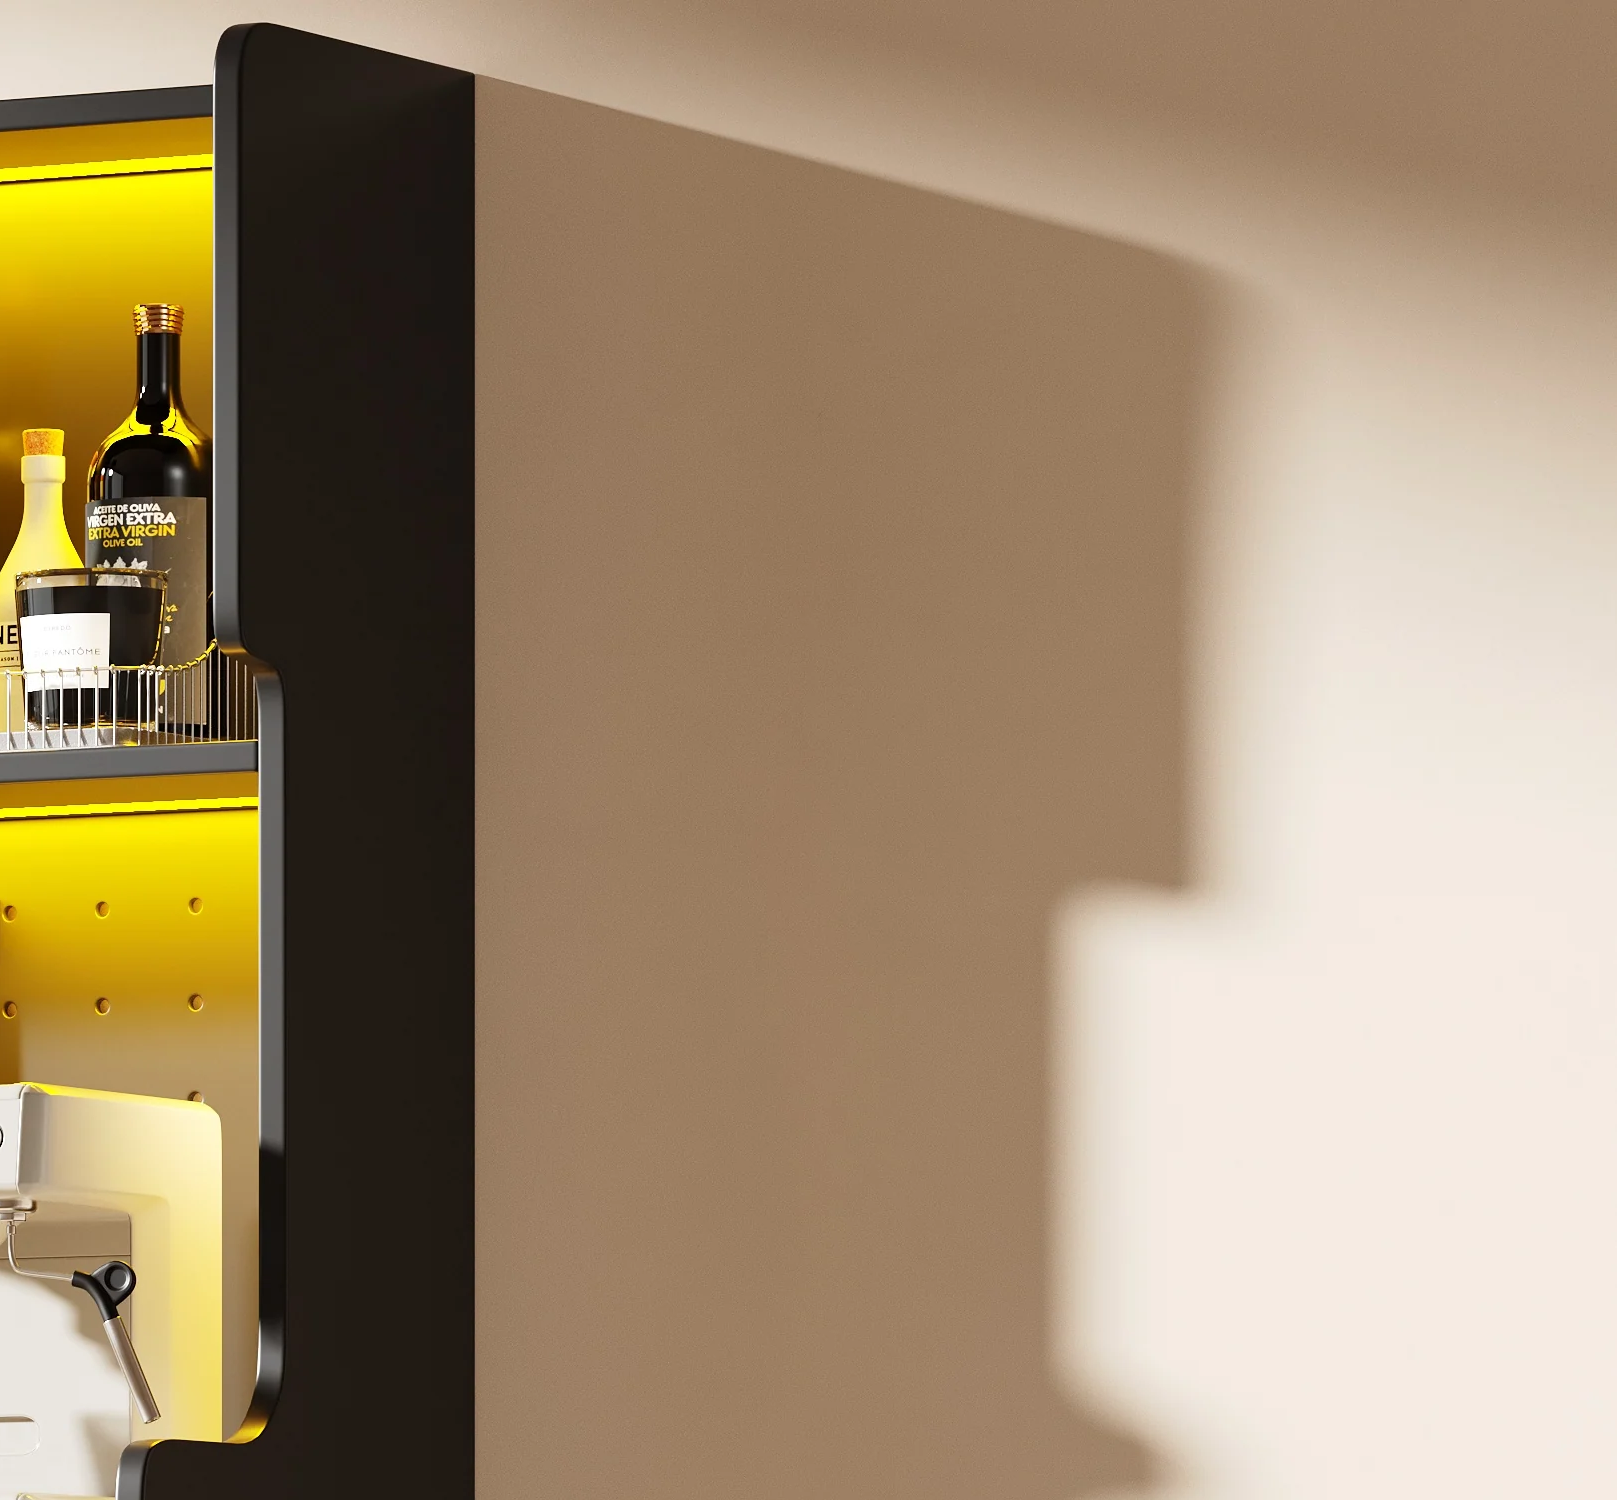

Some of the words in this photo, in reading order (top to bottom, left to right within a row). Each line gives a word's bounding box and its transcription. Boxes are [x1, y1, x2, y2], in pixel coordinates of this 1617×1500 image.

[93, 504, 117, 515] ACEITE
[117, 504, 128, 513] DE
[129, 502, 161, 512] OLIVA
[87, 513, 124, 529] VIRGEN
[125, 511, 177, 525] EXTRA
[88, 526, 120, 541] EXTRA
[120, 524, 176, 538] VIRGIN
[102, 538, 125, 548] OLIVE
[126, 537, 144, 547] OIL
